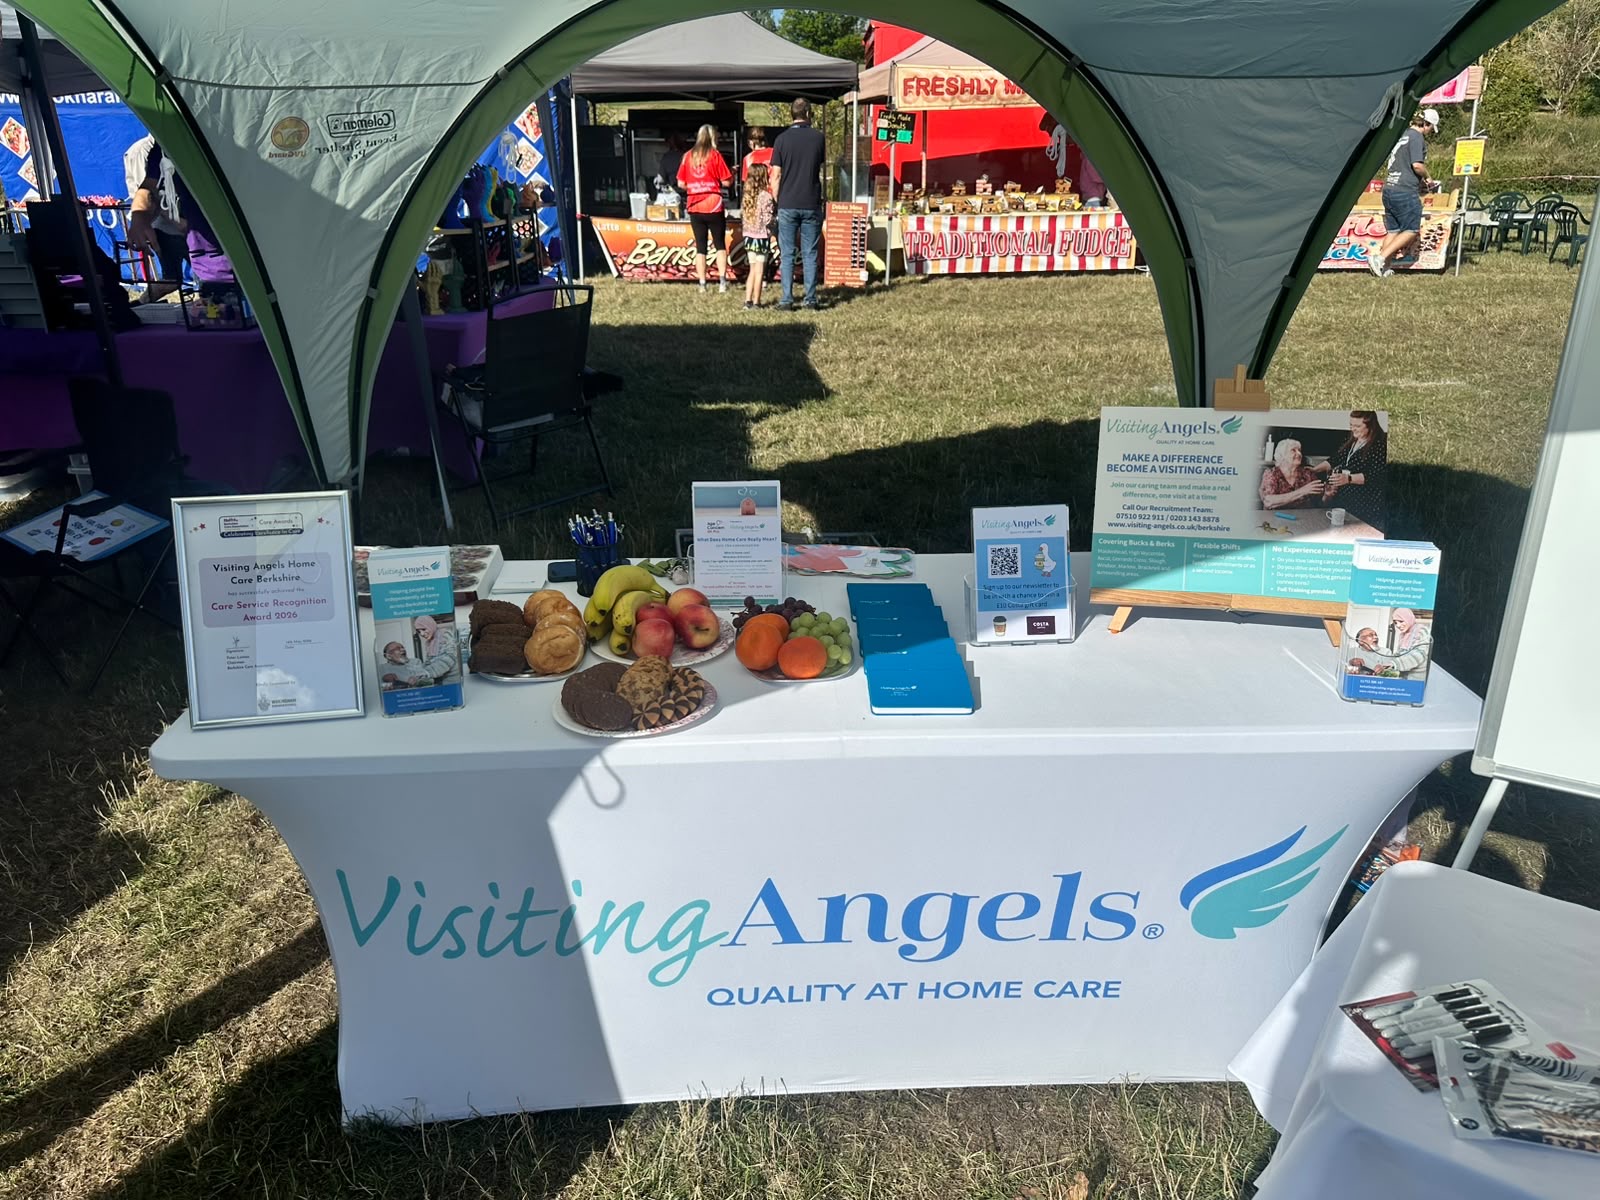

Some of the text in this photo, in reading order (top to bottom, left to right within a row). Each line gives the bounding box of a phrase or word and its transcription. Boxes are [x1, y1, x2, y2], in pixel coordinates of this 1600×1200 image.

[903, 77, 1025, 96] FRESHLY M
[597, 224, 686, 234] Latte Cappuccino
[904, 227, 1132, 261] TRADITIONAL FUDGE
[1106, 418, 1217, 440] Visiting Angels
[1122, 453, 1150, 462] MAKE
[1161, 454, 1223, 464] DIFFERENCE
[1107, 464, 1149, 473] BECOME
[1159, 465, 1204, 474] VISITING
[1204, 466, 1238, 475] ANGEL
[1138, 482, 1159, 490] caring
[1122, 492, 1158, 500] difference,
[981, 518, 1043, 531] Visiting Angels
[1108, 521, 1230, 532] www.visiting-angels.co.uk/berkshire
[1098, 538, 1127, 546] Covering
[1283, 546, 1321, 554] Experience
[213, 560, 316, 573] Visiting Angels Home
[231, 574, 300, 584] Care Berkshire
[211, 597, 327, 610] Care Service Recognition
[243, 612, 272, 622] Award
[336, 868, 729, 987] Visiting
[706, 980, 1122, 1006] QUALITY AT HOME CARE
